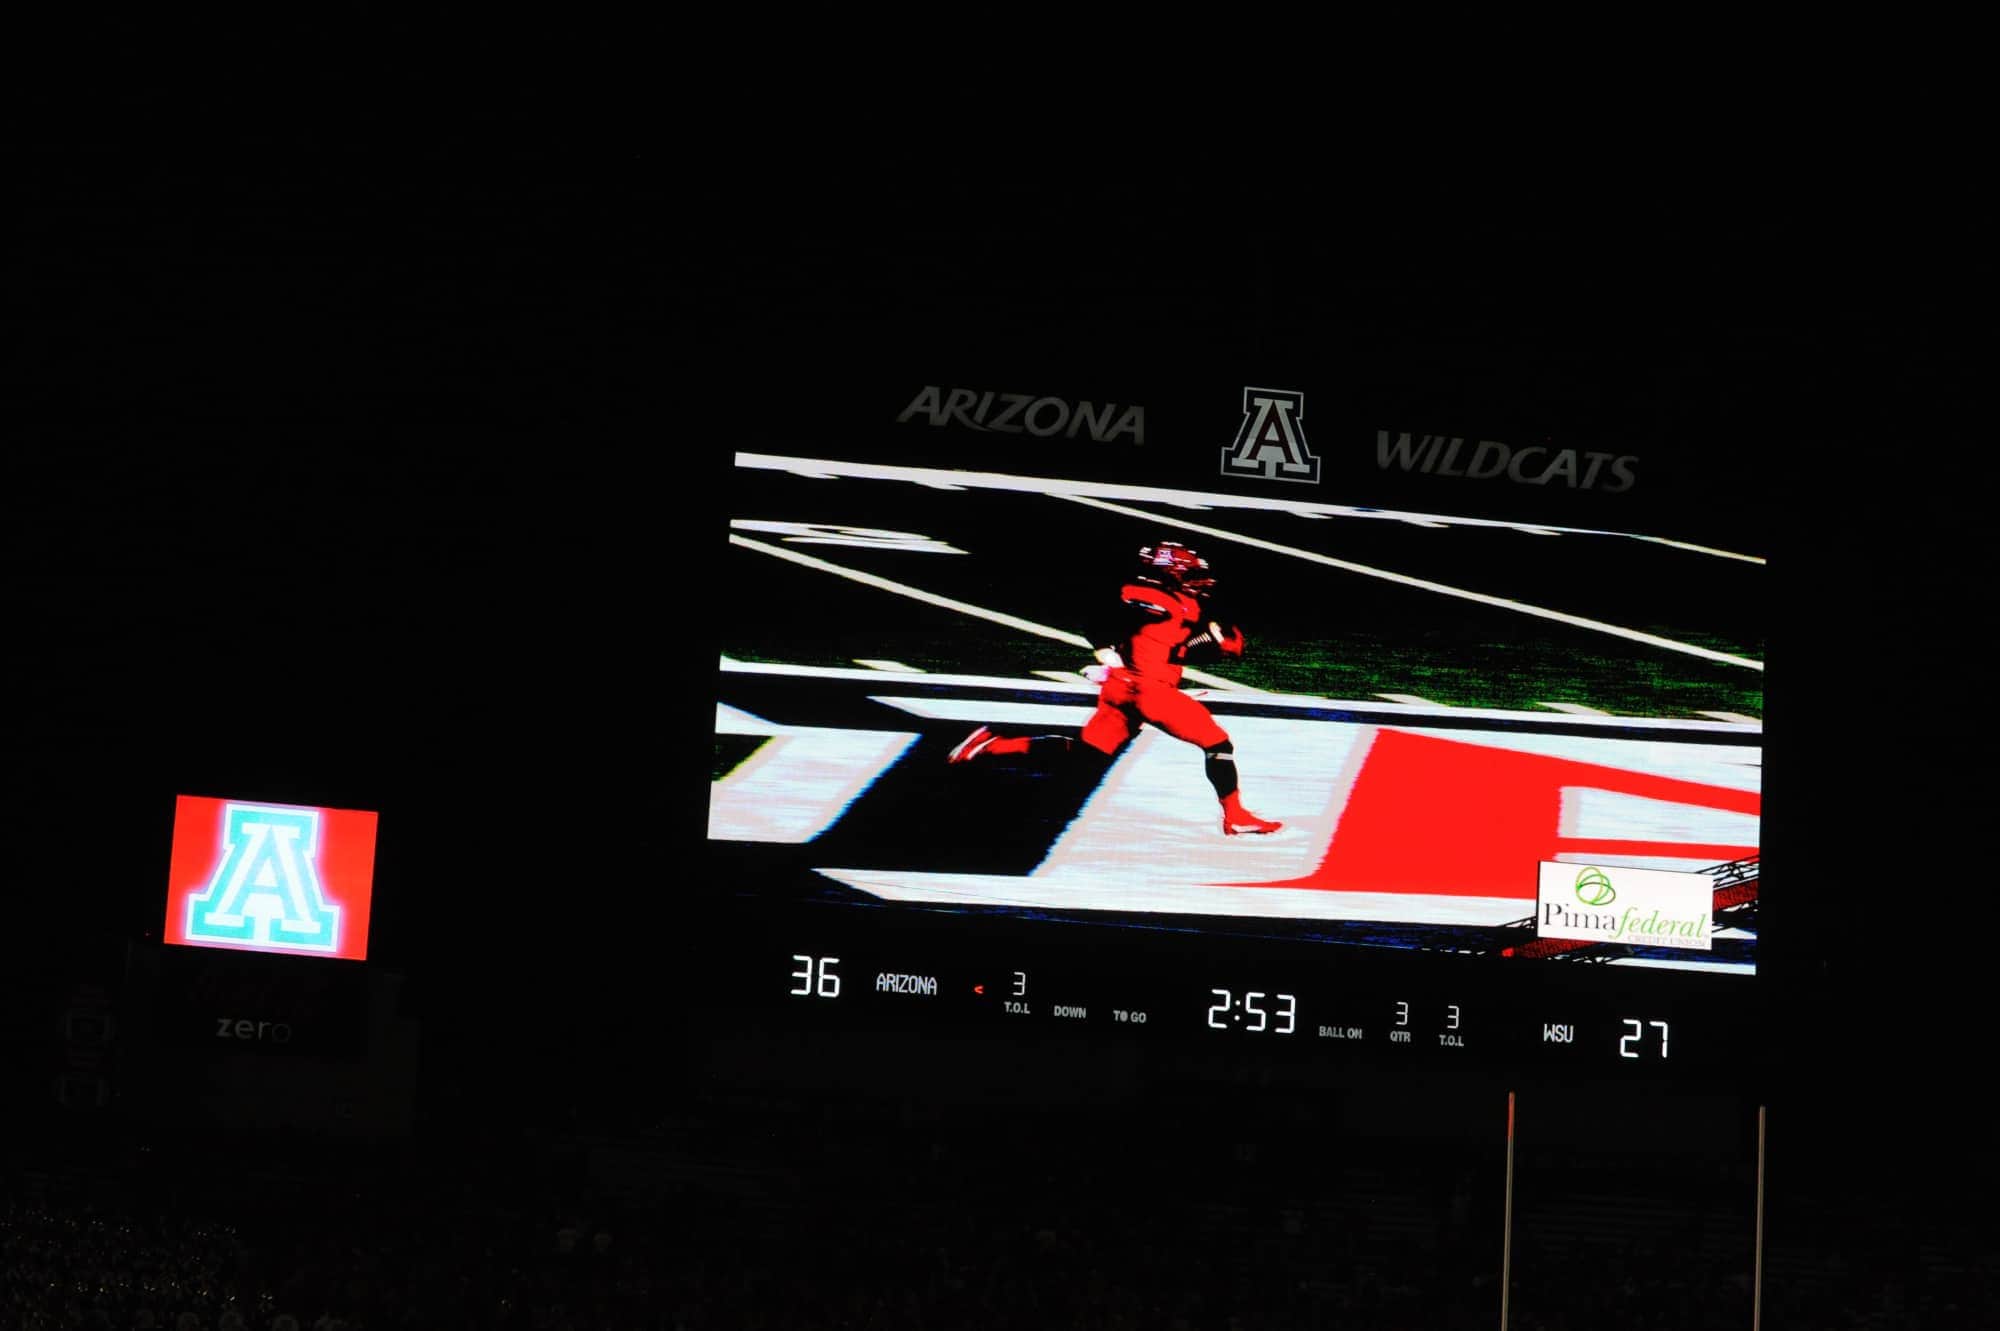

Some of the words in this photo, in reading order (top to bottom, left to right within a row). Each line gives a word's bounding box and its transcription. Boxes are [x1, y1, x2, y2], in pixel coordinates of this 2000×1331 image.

[897, 384, 1146, 447] ARIZONA
[1220, 386, 1321, 485] A
[1376, 429, 1639, 495] WILDCATS
[185, 803, 341, 953] A
[790, 954, 841, 998] 36
[875, 972, 938, 996] ARIZONA
[1012, 971, 1026, 996] 3
[1053, 1004, 1087, 1019] DOWN
[1112, 1009, 1128, 1022] TO
[1130, 1011, 1147, 1024] GO
[1207, 988, 1297, 1034] 2:53
[1395, 1001, 1409, 1026] 3
[1447, 1005, 1460, 1029] 3
[215, 1016, 293, 1042] zero
[1318, 1025, 1345, 1039] BALL
[1346, 1027, 1363, 1040] ON
[1389, 1030, 1411, 1043] QTR
[1543, 1023, 1575, 1044] WSU
[1619, 1018, 1669, 1059] 27
